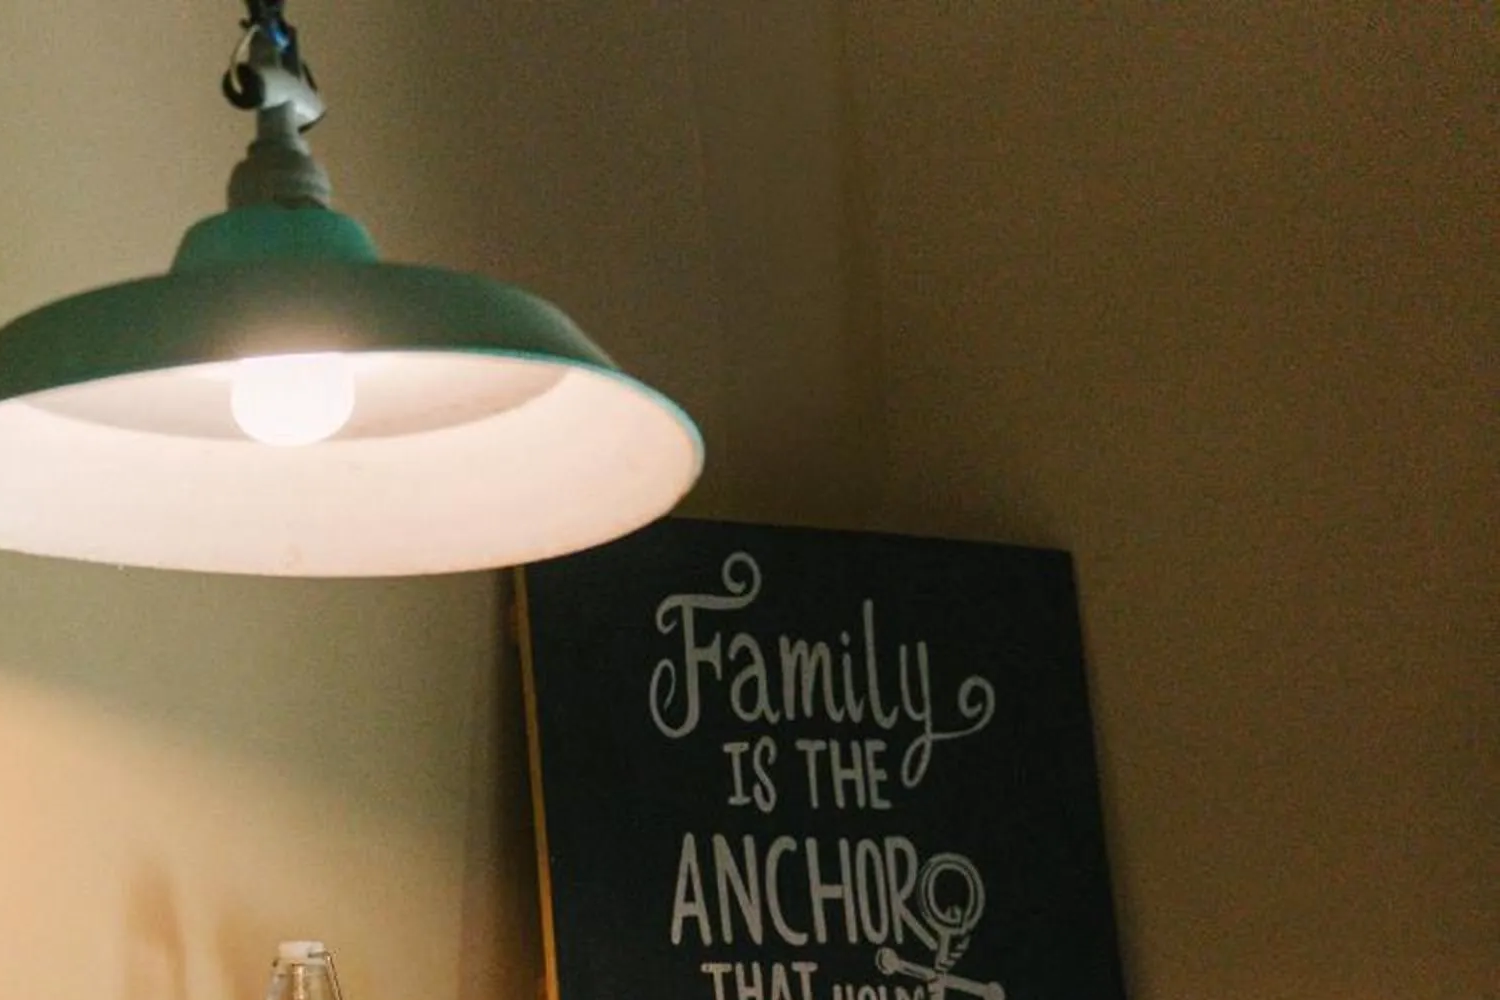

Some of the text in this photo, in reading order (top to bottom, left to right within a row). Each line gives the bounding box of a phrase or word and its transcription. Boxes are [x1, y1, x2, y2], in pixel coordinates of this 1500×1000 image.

[650, 551, 995, 787] Family
[722, 736, 892, 812] IS THE
[671, 832, 939, 951] ANCHOR
